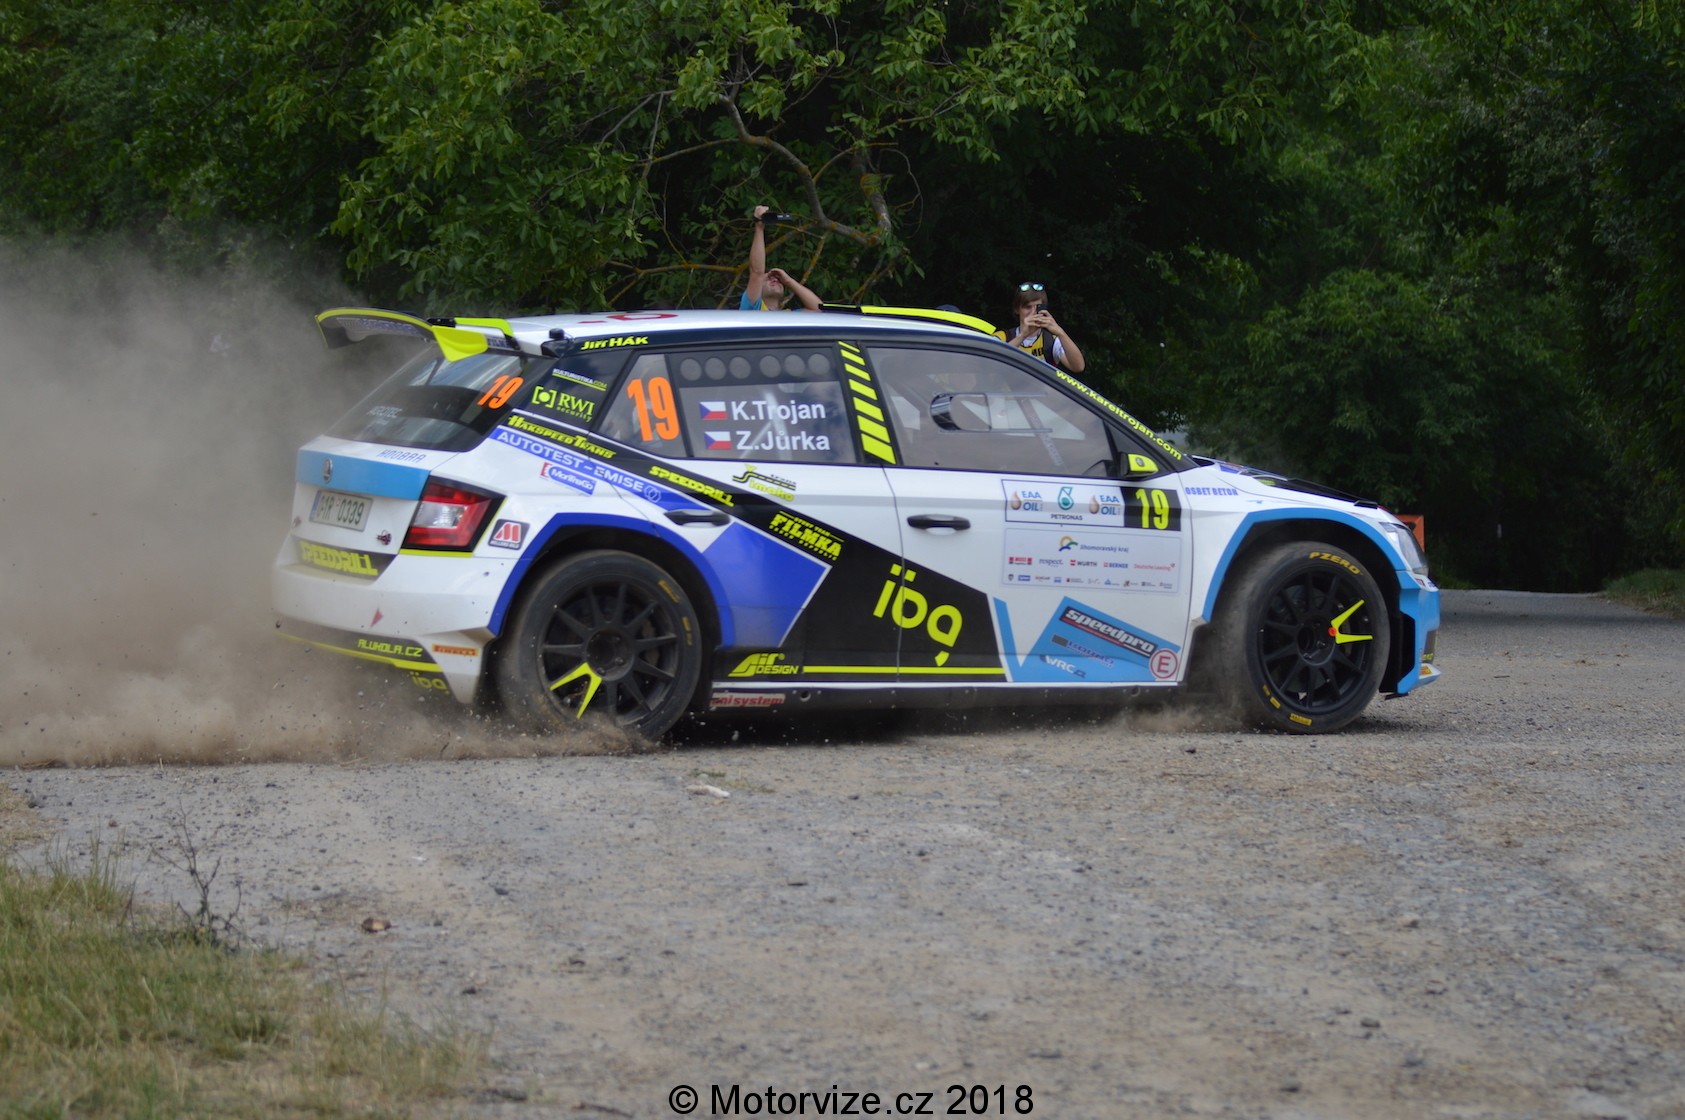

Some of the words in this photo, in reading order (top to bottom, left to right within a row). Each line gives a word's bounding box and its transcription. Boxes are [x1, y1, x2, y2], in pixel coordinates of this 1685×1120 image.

[609, 335, 649, 347] HÁK
[477, 374, 524, 410] 19
[558, 392, 596, 416] RWI
[626, 376, 680, 442] 19
[731, 400, 826, 424] K.Trojan
[556, 406, 593, 423] security
[1055, 369, 1182, 461] www.kareltrojan.com
[736, 430, 831, 451] Z.Jůrka
[497, 431, 587, 470] AUTOTEST
[593, 467, 644, 492] EMISE
[1021, 490, 1042, 499] EAA
[1099, 494, 1120, 503] EAA
[1185, 487, 1211, 496] OSBET
[337, 498, 365, 526] 0339
[1023, 502, 1039, 512] OIL
[1101, 506, 1117, 516] OIL
[1135, 488, 1169, 530] 19
[771, 513, 842, 557] FILMKA
[1065, 608, 1156, 654] speedpro
[357, 638, 424, 658] ALUKOLA.CZ
[755, 664, 800, 675] DESIGN
[1045, 655, 1076, 674] WRC
[1157, 655, 1171, 673] E
